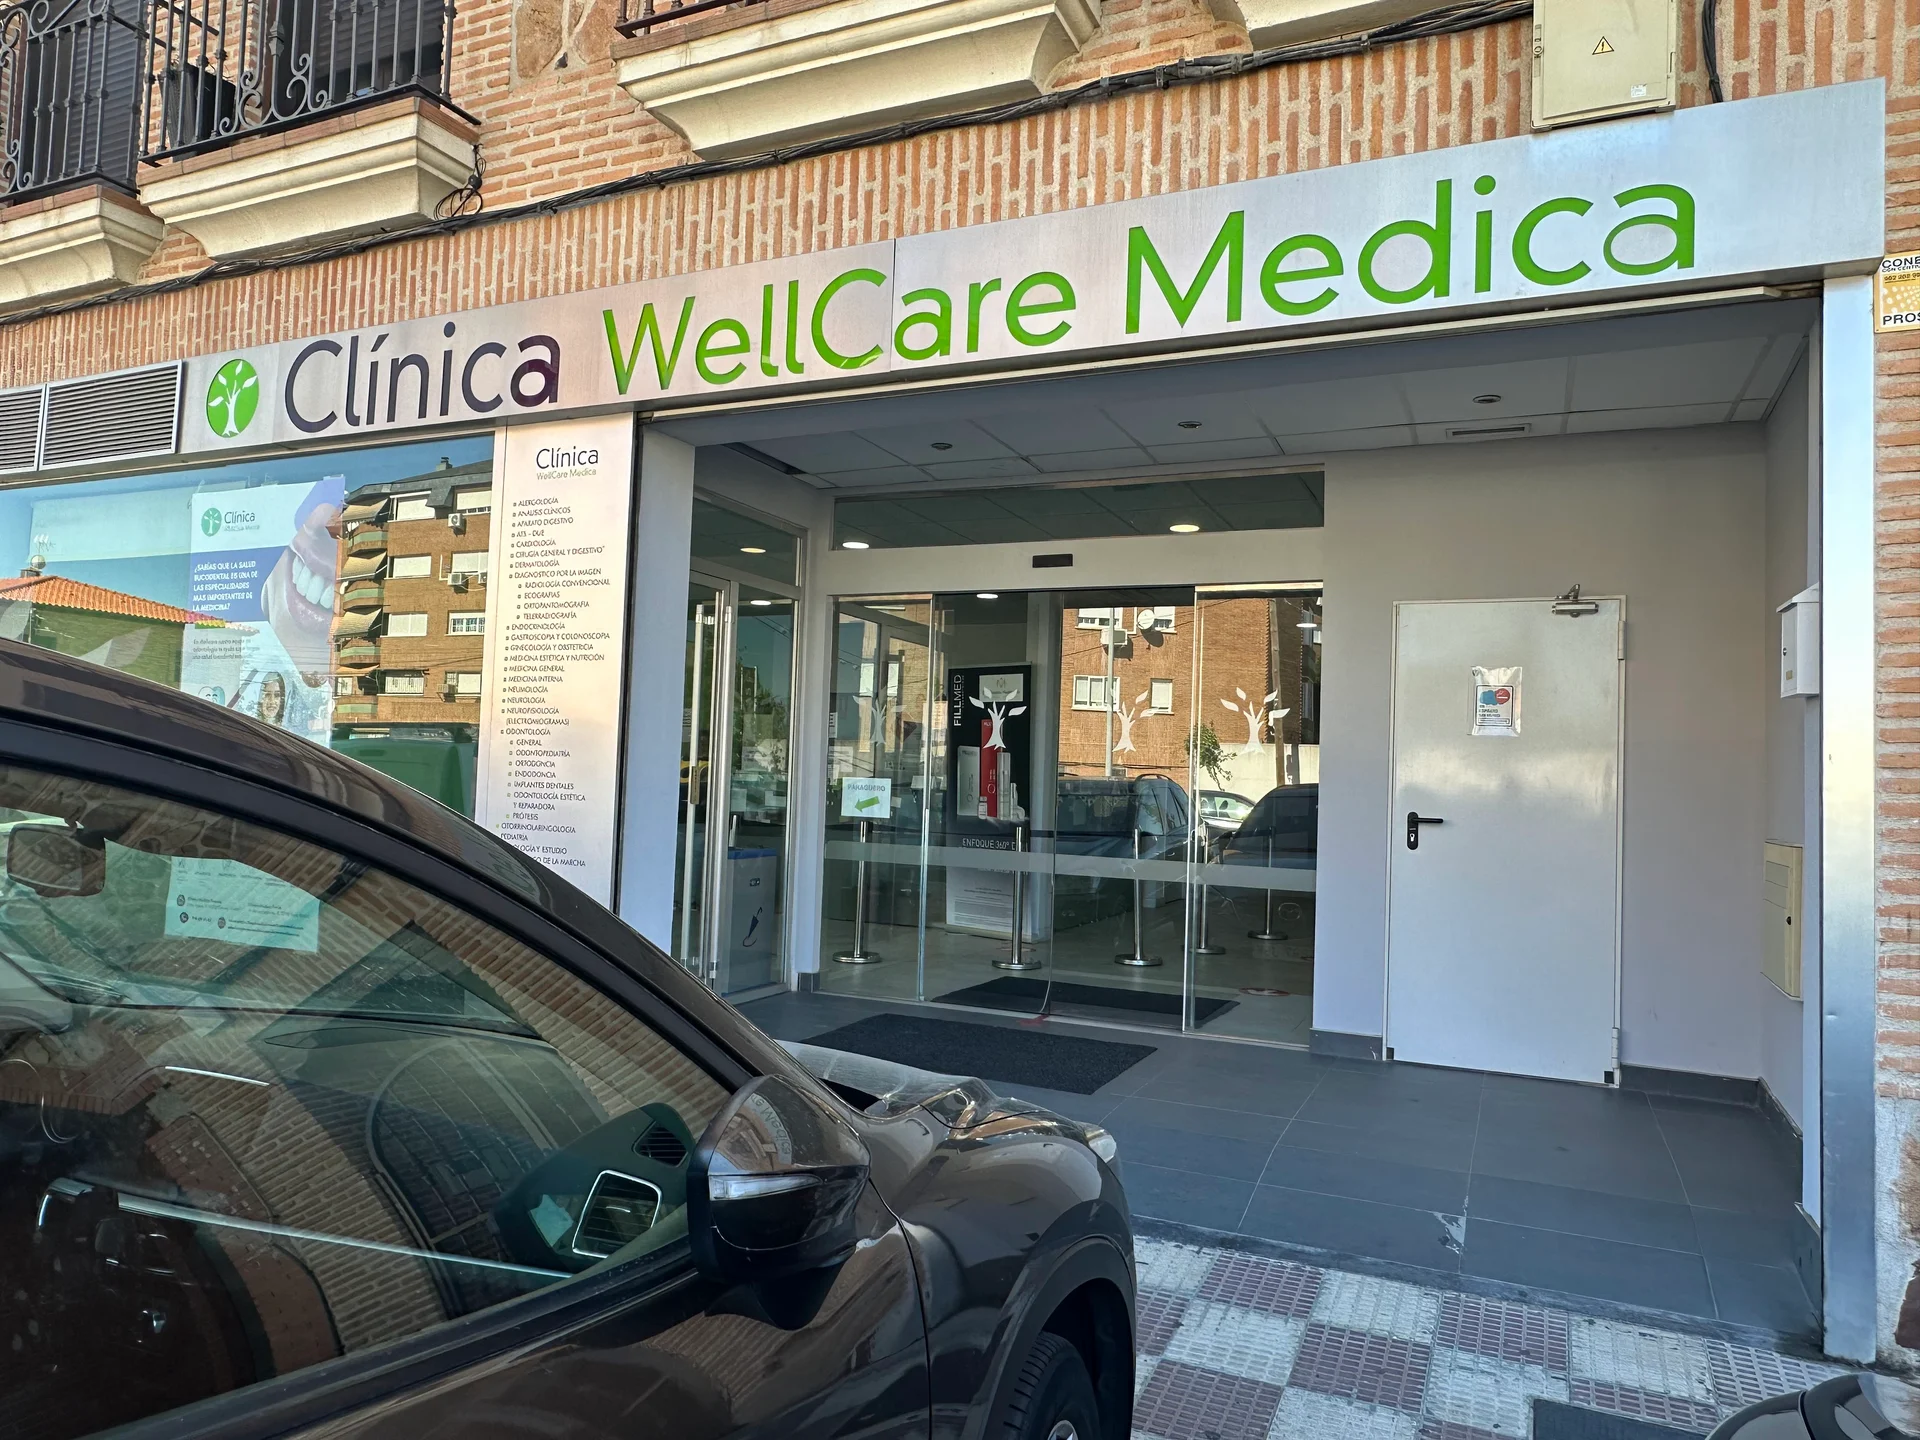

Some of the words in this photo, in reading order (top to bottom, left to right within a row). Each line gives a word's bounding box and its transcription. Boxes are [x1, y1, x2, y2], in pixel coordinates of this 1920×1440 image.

[284, 321, 560, 434] Clínica
[603, 267, 1077, 396] WellCare
[1125, 175, 1695, 335] Medica
[536, 446, 599, 469] Clínica
[224, 510, 255, 523] Clínica
[953, 674, 961, 727] FILLMED
